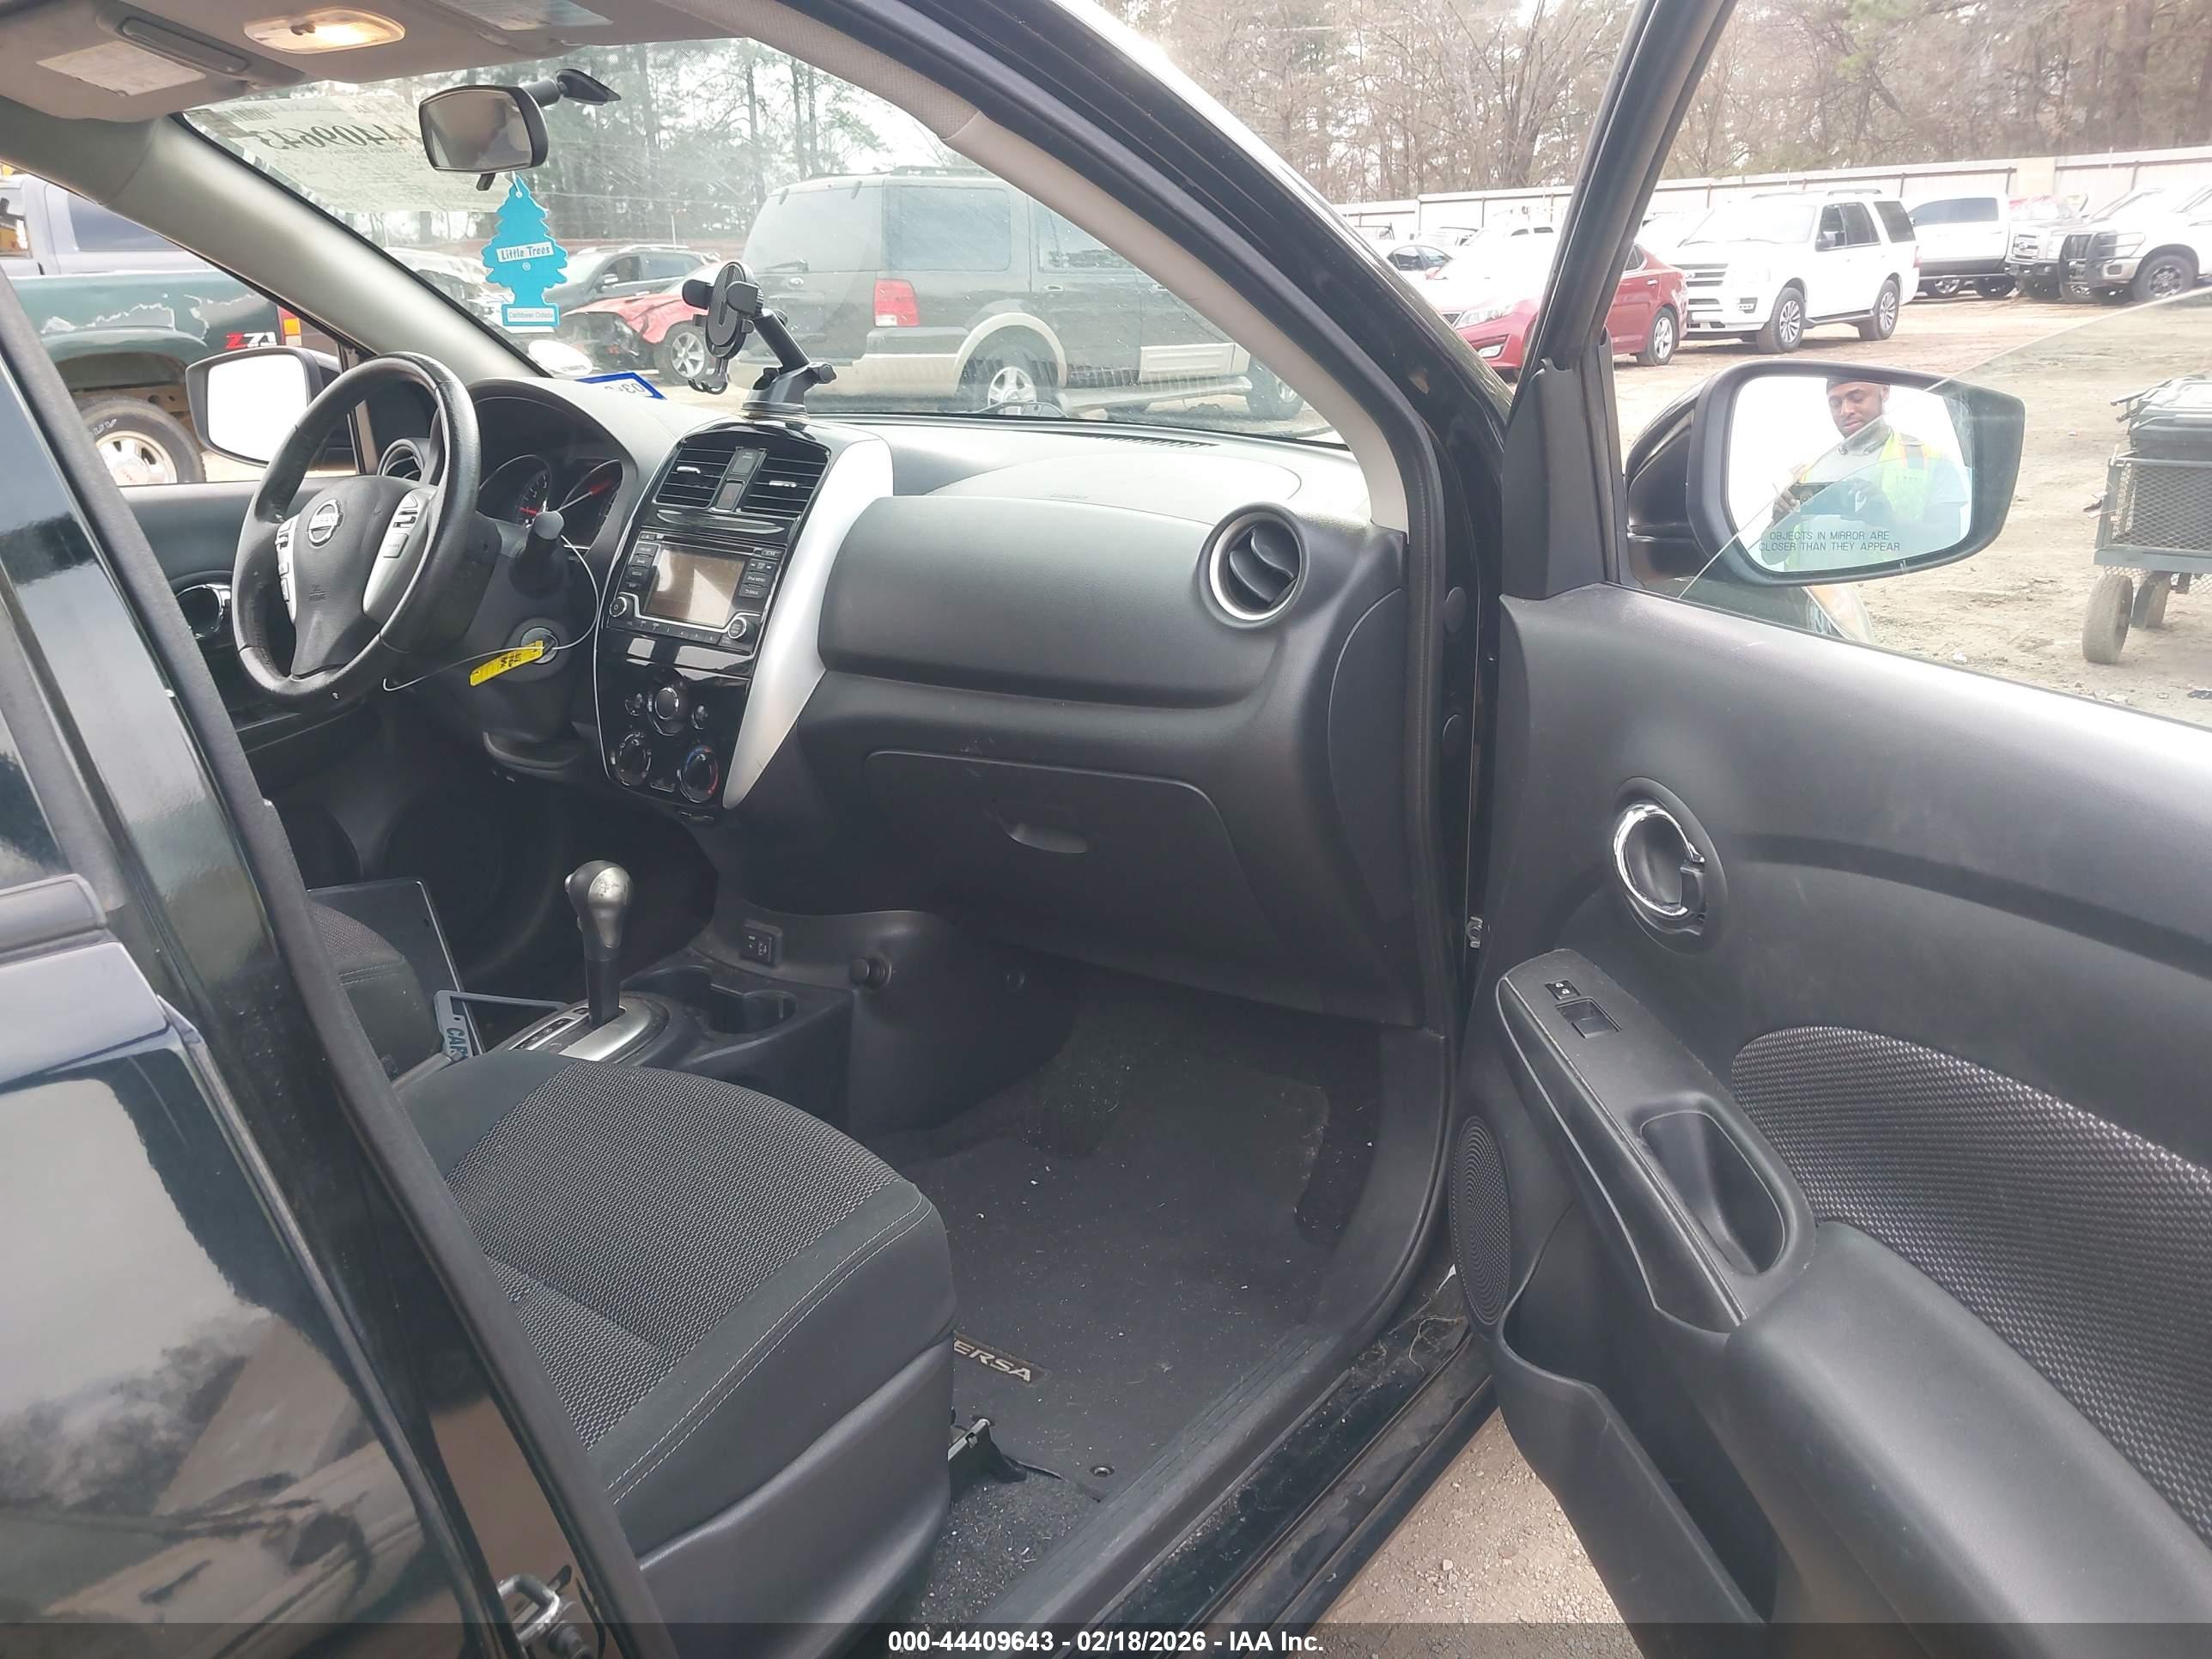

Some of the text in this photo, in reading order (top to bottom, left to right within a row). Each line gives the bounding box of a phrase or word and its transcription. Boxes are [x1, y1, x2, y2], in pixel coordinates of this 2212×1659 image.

[501, 245, 550, 261] Little Trees
[226, 331, 278, 349] Z71
[1769, 531, 1890, 541] OBJECTS IN MIRROR ARE
[1759, 542, 1900, 551] CLOSER THAN THEY APPEAR
[446, 1028, 467, 1059] CAR
[952, 1339, 1031, 1382] ERSA
